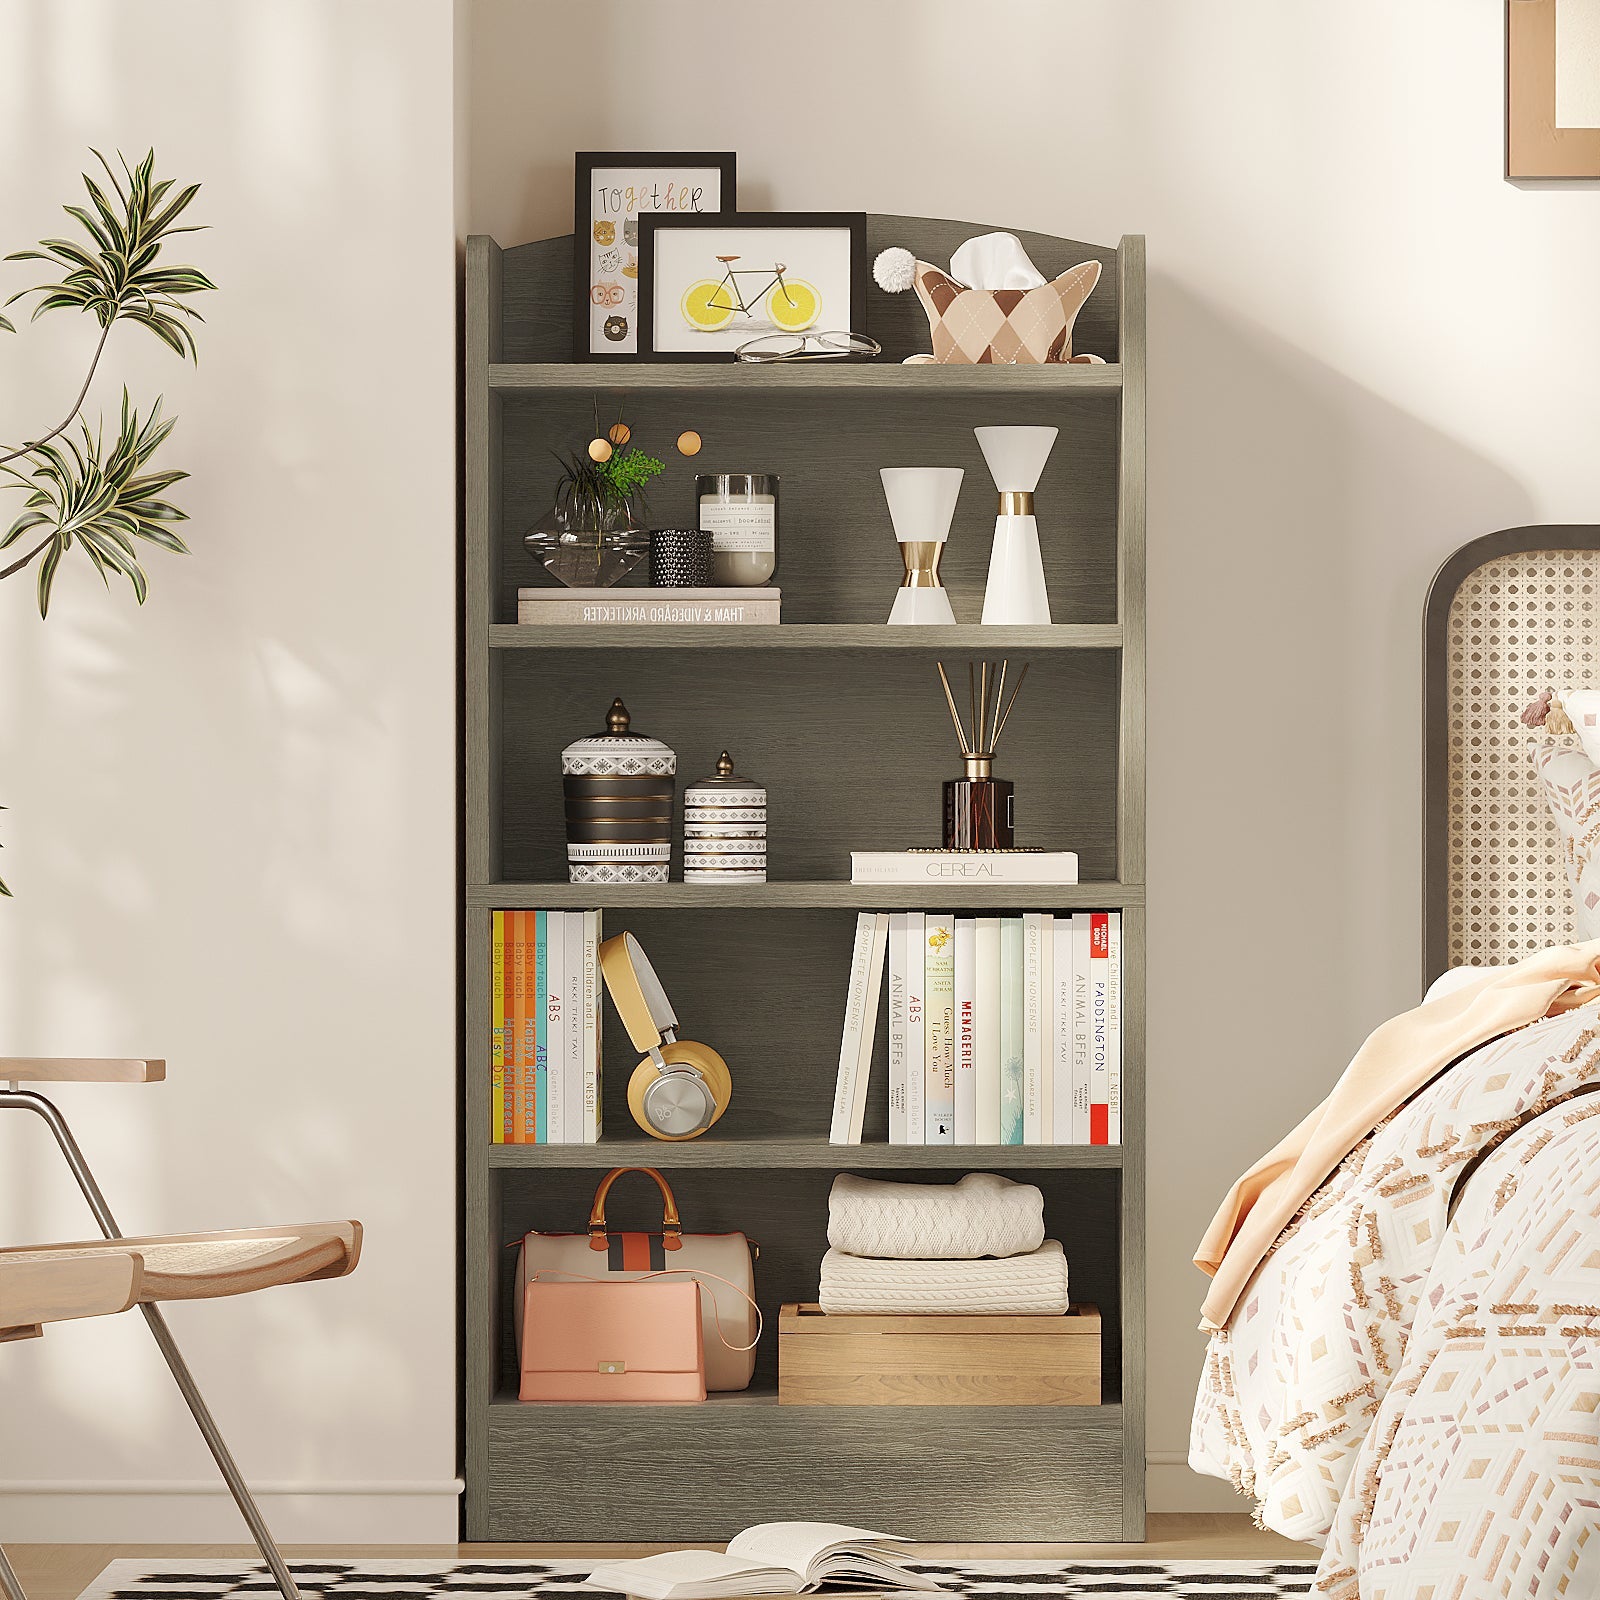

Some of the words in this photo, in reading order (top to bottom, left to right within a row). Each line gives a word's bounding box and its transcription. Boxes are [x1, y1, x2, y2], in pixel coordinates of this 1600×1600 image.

[925, 863, 1003, 877] CEREAL
[494, 943, 503, 966] Baby
[505, 943, 514, 966] Baby
[515, 943, 524, 966] Baby
[526, 943, 535, 966] Baby
[537, 943, 546, 966] Baby
[585, 940, 594, 958] Five
[857, 924, 871, 976] COMPLETE
[1029, 924, 1037, 977] COMPLETE
[1110, 942, 1118, 959] Five
[494, 971, 503, 999] touch
[505, 971, 514, 999] touch
[515, 971, 524, 999] touch
[526, 971, 535, 999] touch
[537, 971, 546, 999] touch
[585, 962, 595, 999] Children
[1110, 962, 1119, 1001] Children
[548, 994, 561, 1022] ABS
[585, 1002, 594, 1019] and
[850, 981, 863, 1032] NONSENSE
[909, 995, 921, 1023] ABS
[943, 1007, 953, 1034] Guess
[1029, 981, 1037, 1033] NONSENSE
[1110, 1004, 1118, 1020] and
[932, 1029, 941, 1051] Love
[961, 1001, 972, 1069] MENAGERIE
[1094, 982, 1105, 1072] PADDINGTON
[493, 1027, 504, 1058] Busy
[944, 1038, 953, 1059] How
[536, 1045, 547, 1071] ABC
[932, 1055, 941, 1073] You
[493, 1065, 504, 1088] Day
[944, 1062, 953, 1089] Much
[585, 1082, 594, 1113] NESBIT
[1110, 1084, 1118, 1115] NESBIT
